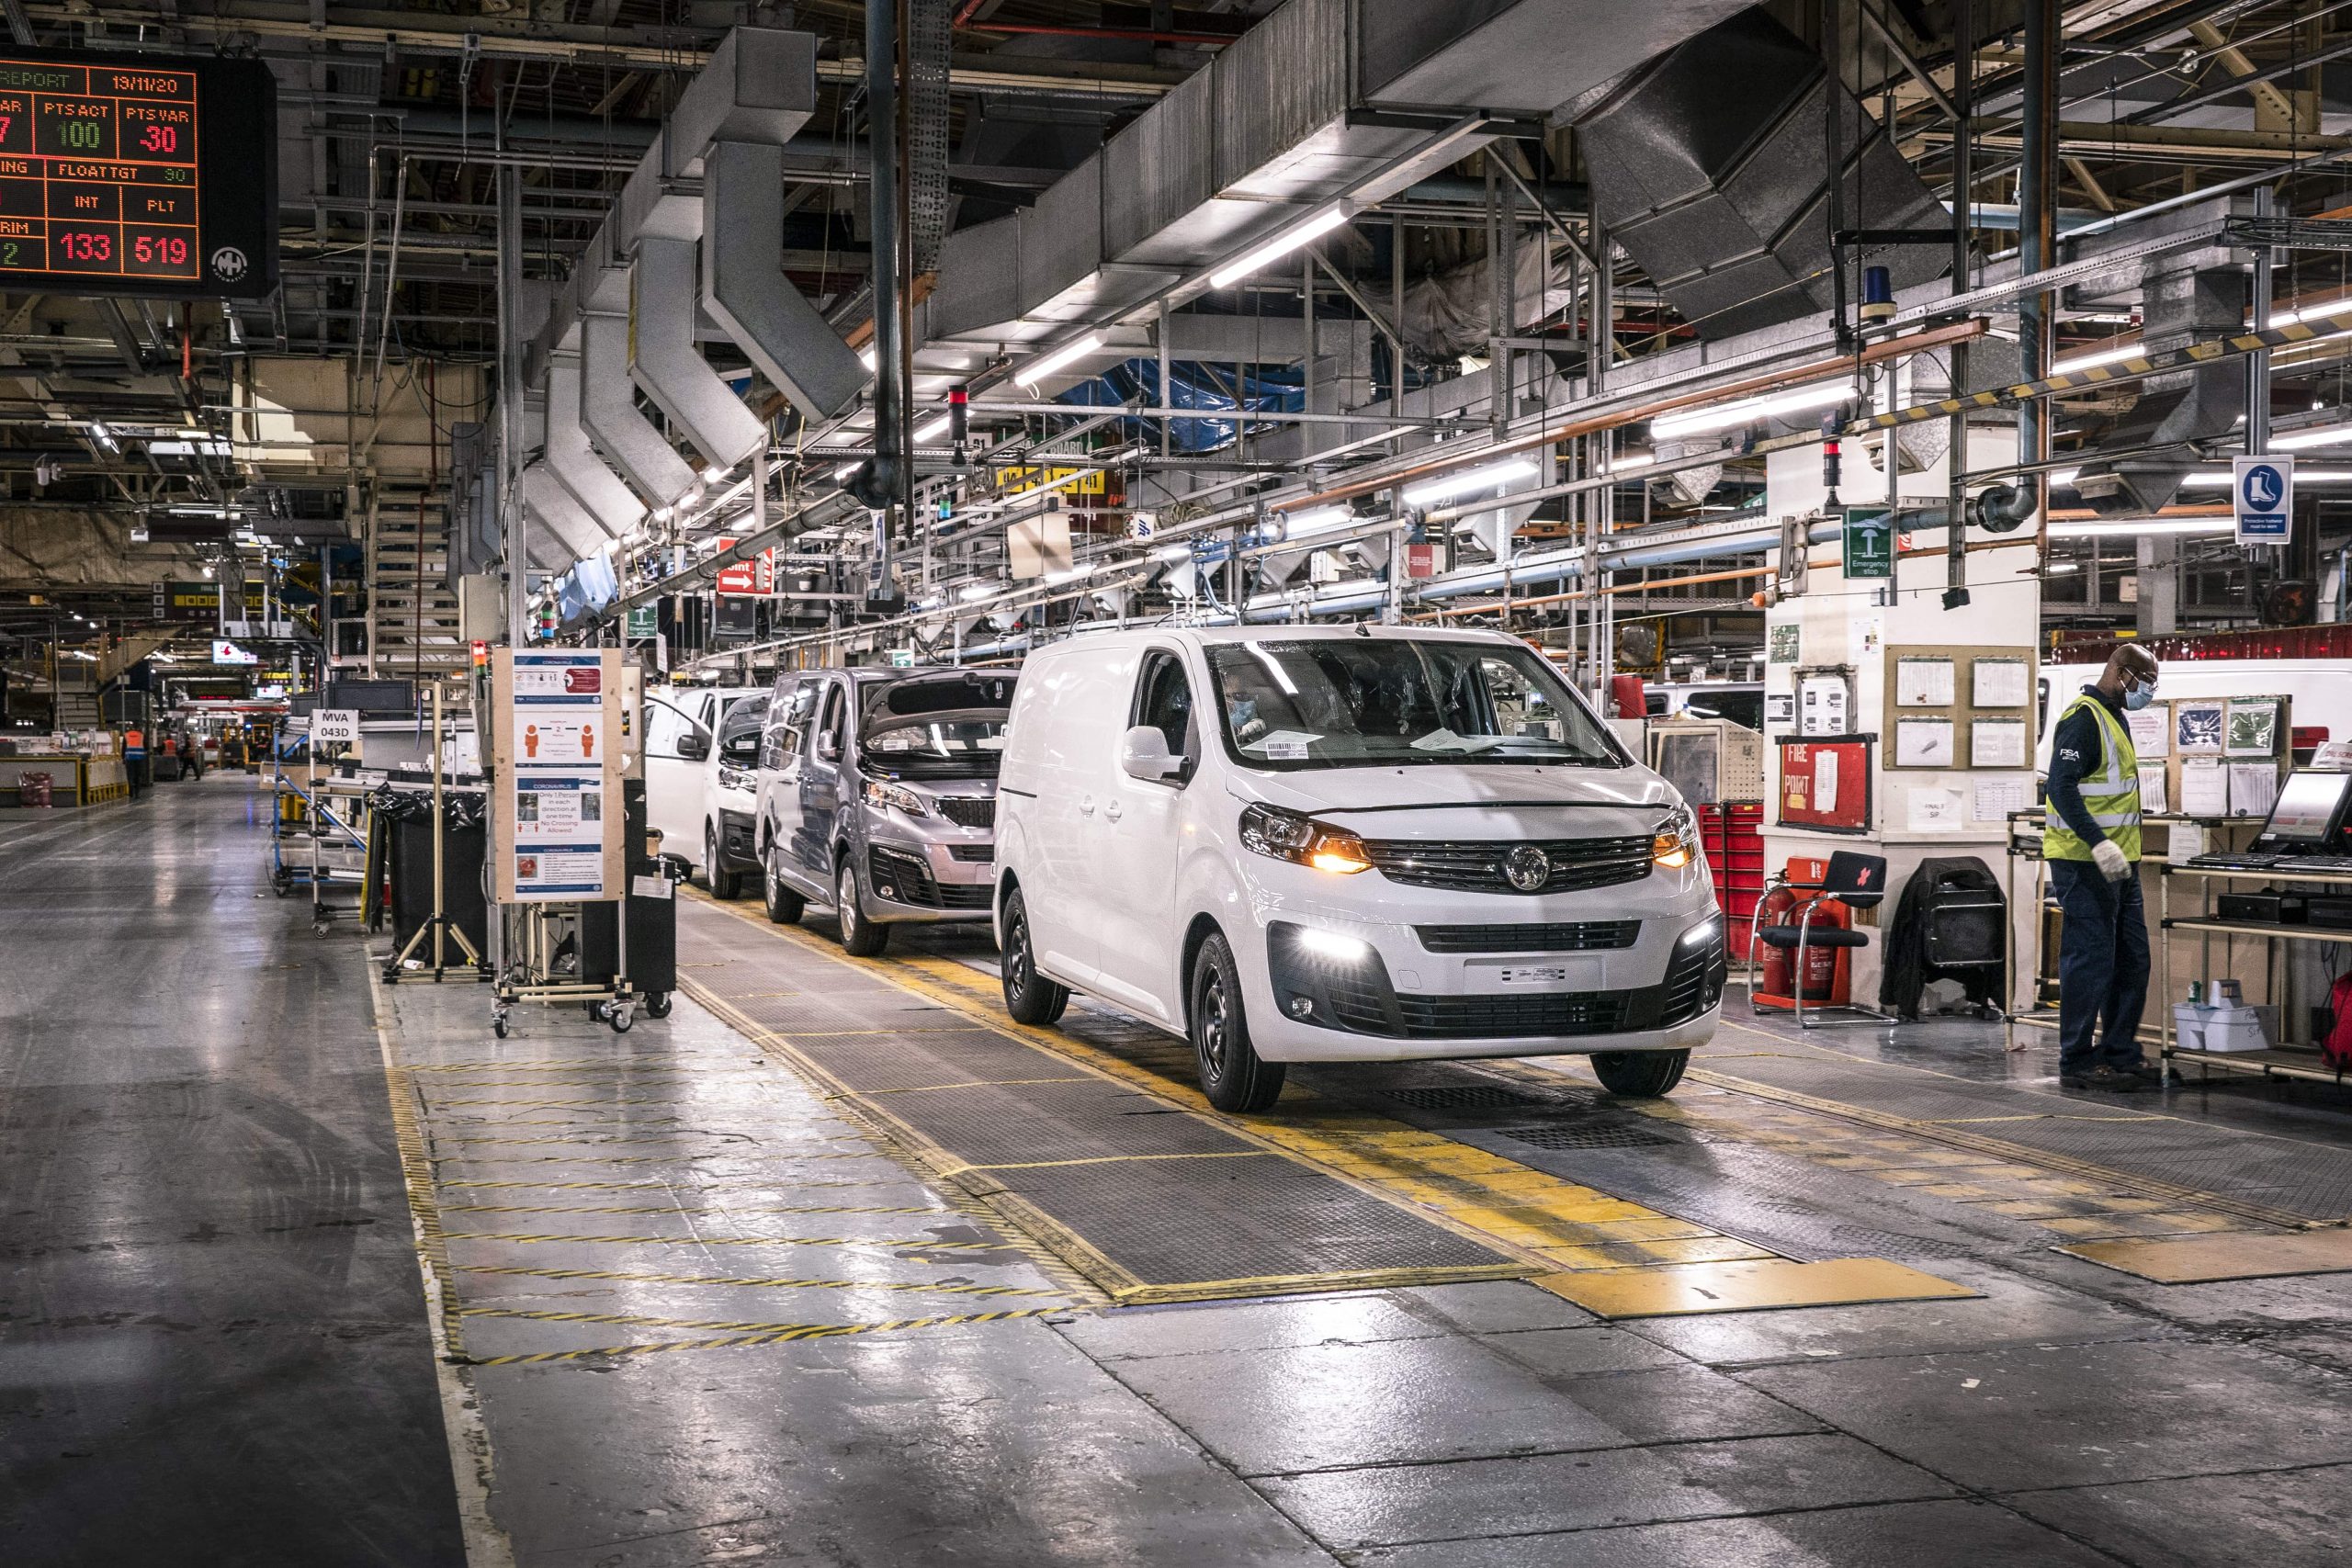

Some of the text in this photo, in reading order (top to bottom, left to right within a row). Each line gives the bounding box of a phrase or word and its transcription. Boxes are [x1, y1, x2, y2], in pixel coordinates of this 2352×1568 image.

[112, 75, 177, 93] 19/11/20
[44, 102, 108, 118] PTS ACT
[126, 107, 189, 122] PTS VAR
[57, 120, 100, 148] 100
[140, 125, 176, 152] -30
[58, 164, 107, 178] FLOAT
[110, 167, 138, 179] TGT
[74, 196, 99, 209] INT
[147, 199, 175, 212] PLT
[61, 232, 111, 260] 133
[134, 236, 187, 265] 519
[1852, 560, 1889, 569] Emergency
[1863, 568, 1879, 576] stop
[322, 713, 348, 723] MVA
[321, 728, 349, 738] 043D
[1788, 743, 1808, 762] FIRE
[2059, 749, 2080, 759] PSA
[1784, 774, 1810, 795] POINT
